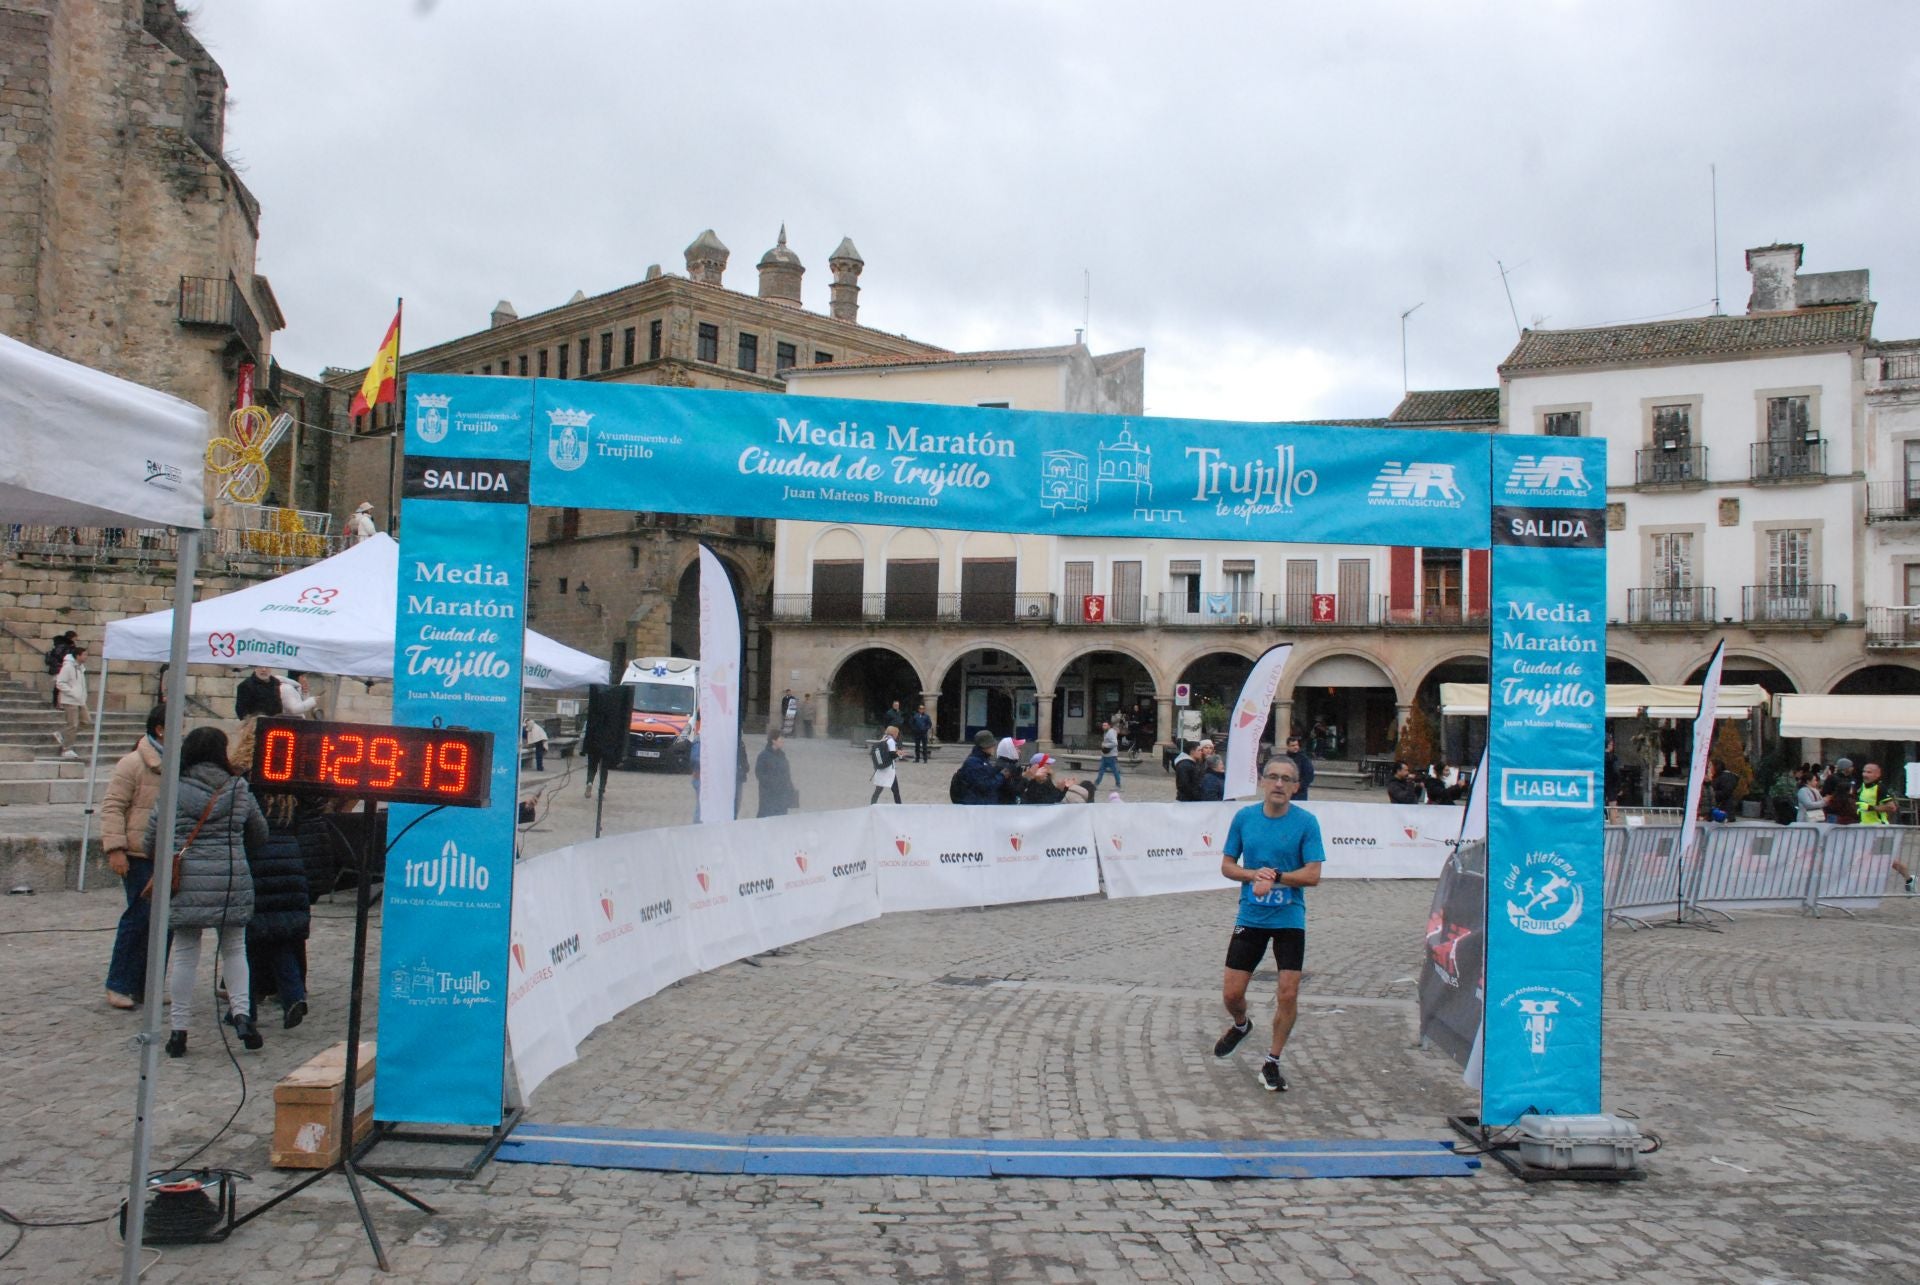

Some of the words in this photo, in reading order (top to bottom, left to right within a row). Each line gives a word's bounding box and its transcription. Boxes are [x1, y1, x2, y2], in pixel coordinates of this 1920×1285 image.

[455, 411, 509, 422] Ayuntamiento
[510, 412, 521, 421] de
[454, 420, 498, 435] Trujillo
[598, 431, 668, 445] Ayuntamiento
[669, 435, 682, 445] de
[776, 418, 877, 450] Media
[885, 425, 1017, 458] Maratón
[596, 443, 654, 461] Trujillo
[423, 469, 509, 492] SALIDA
[738, 446, 842, 479] Ciudad
[845, 455, 885, 482] de
[891, 456, 992, 496] Trujillo
[1185, 444, 1318, 507] Trujillo
[782, 485, 816, 501] Juan
[819, 487, 870, 503] Mateos
[873, 491, 939, 507] Broncano
[1505, 487, 1588, 497] www.musicrun.es
[1216, 497, 1231, 516] te
[1368, 497, 1461, 509] www.musicrun.es
[1511, 518, 1589, 538] SALIDA
[414, 562, 510, 586] Media
[260, 603, 336, 616] primaflor
[407, 595, 515, 618] Maratón
[1507, 601, 1592, 623] Media
[420, 624, 476, 642] Ciudad
[478, 628, 499, 644] de
[1502, 631, 1599, 653] Maratón
[237, 639, 300, 657] primaflor
[404, 645, 511, 688] Trujillo
[1513, 659, 1562, 675] Ciudad
[1564, 662, 1584, 675] de
[408, 690, 428, 700] Juan
[430, 690, 462, 701] Mateos
[464, 692, 507, 703] Broncano
[1500, 677, 1596, 716] Trujillo
[1514, 779, 1580, 798] HABLA
[405, 839, 489, 896] trujillo
[1503, 863, 1521, 890] Club
[1525, 850, 1578, 878] Atletismo
[436, 970, 490, 995] Trujillo
